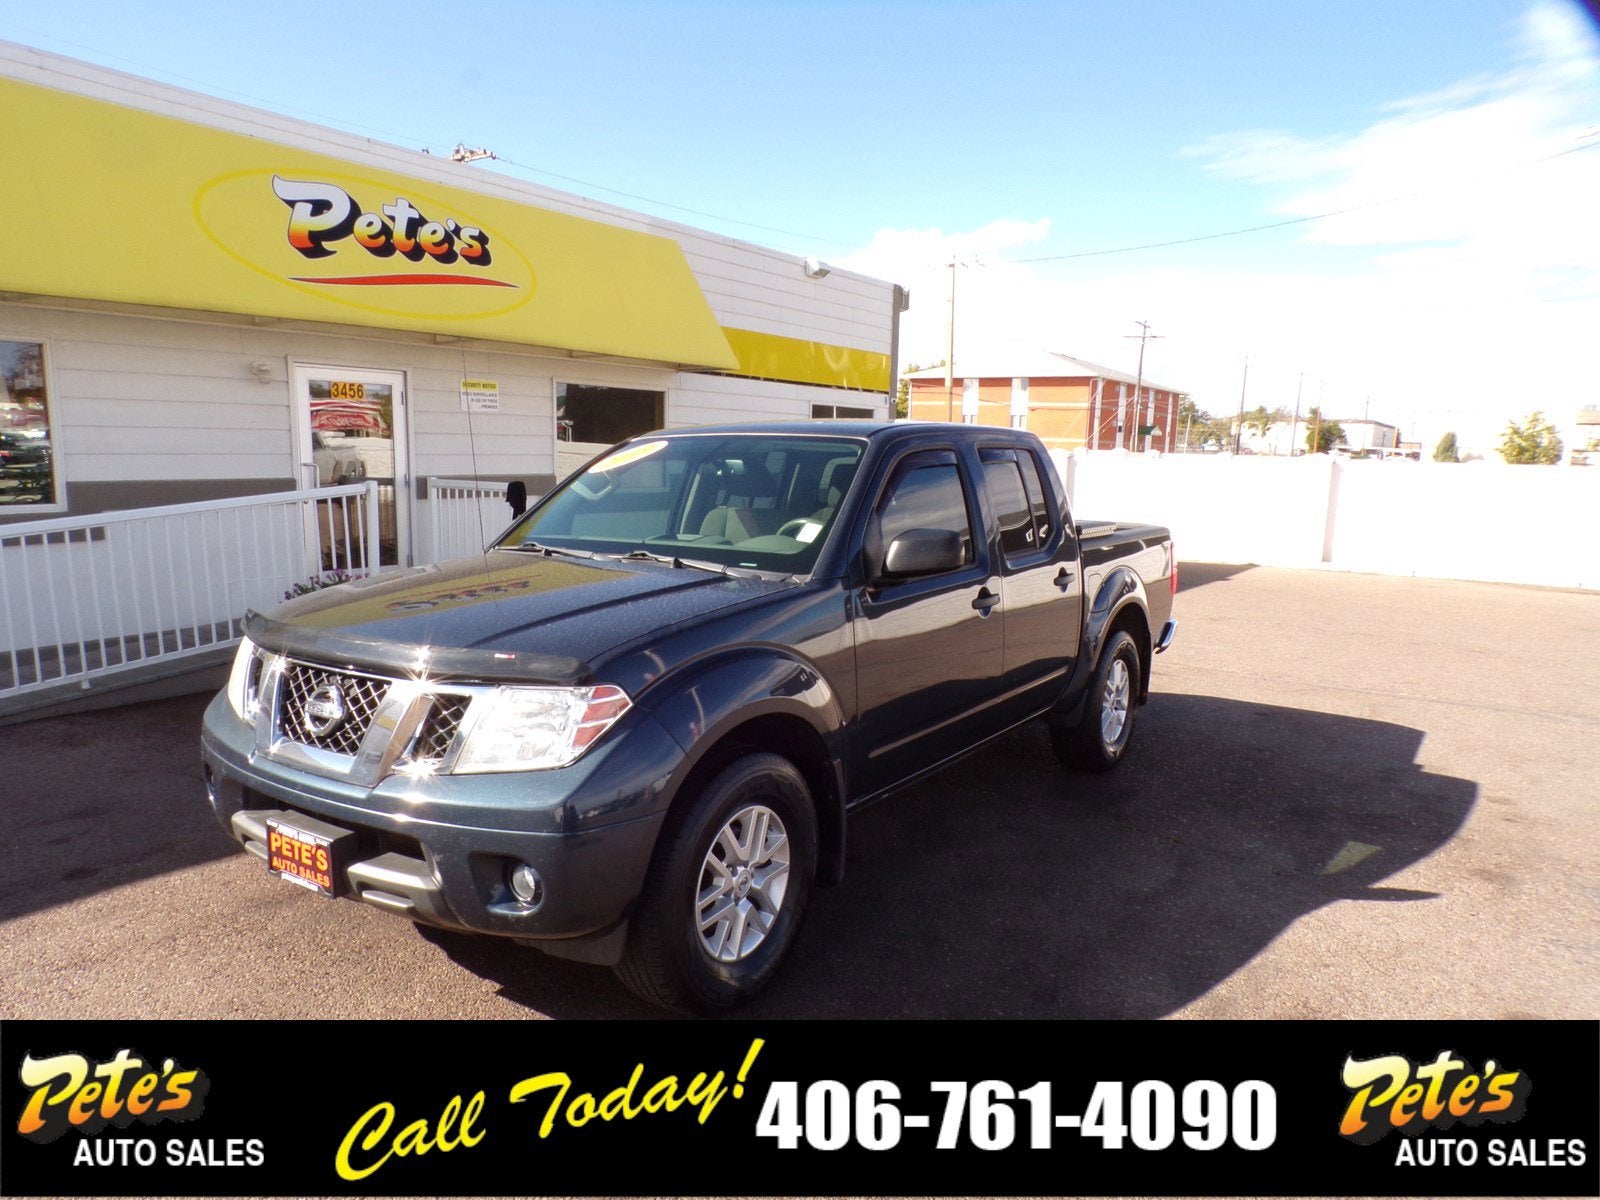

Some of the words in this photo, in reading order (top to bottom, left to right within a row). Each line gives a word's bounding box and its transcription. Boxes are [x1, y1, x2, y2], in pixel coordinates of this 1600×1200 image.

[272, 175, 492, 267] Pete's
[331, 382, 364, 399] 3456
[270, 832, 329, 871] PETE'S
[272, 856, 297, 875] AUTO
[299, 866, 331, 888] SALES
